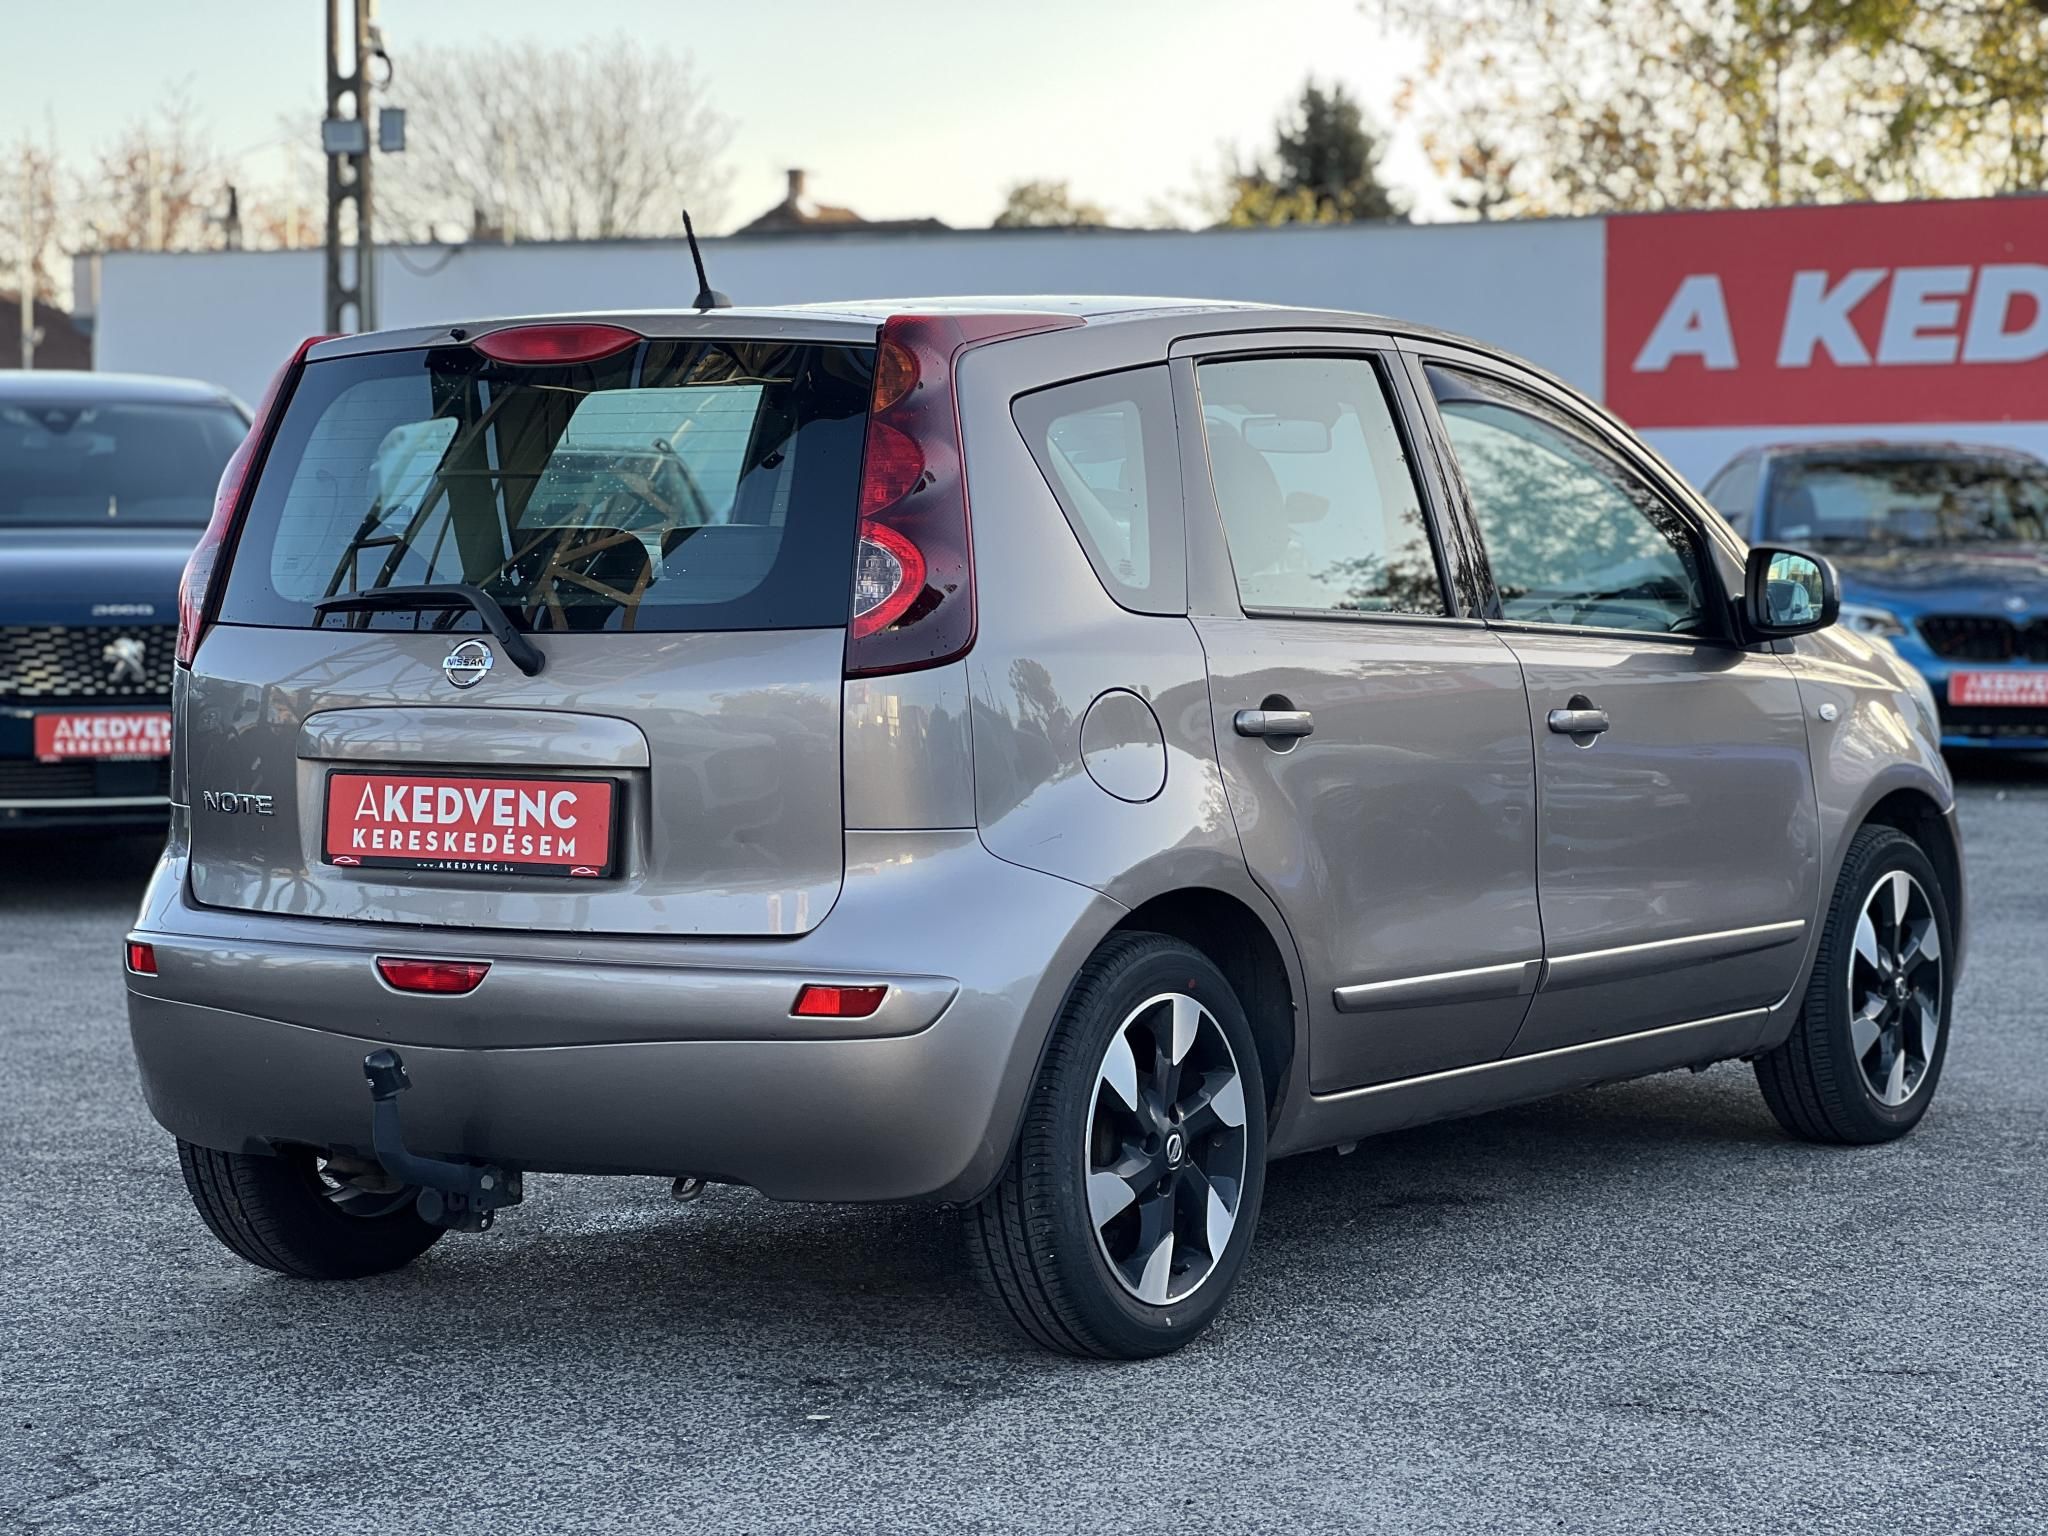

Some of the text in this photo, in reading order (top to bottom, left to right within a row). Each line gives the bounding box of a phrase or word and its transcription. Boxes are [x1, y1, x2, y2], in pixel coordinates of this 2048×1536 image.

[1632, 263, 2048, 373] A KED
[447, 657, 486, 667] NISSAN
[203, 790, 275, 816] NOTE
[352, 827, 576, 858] KERESKEDÉSEM
